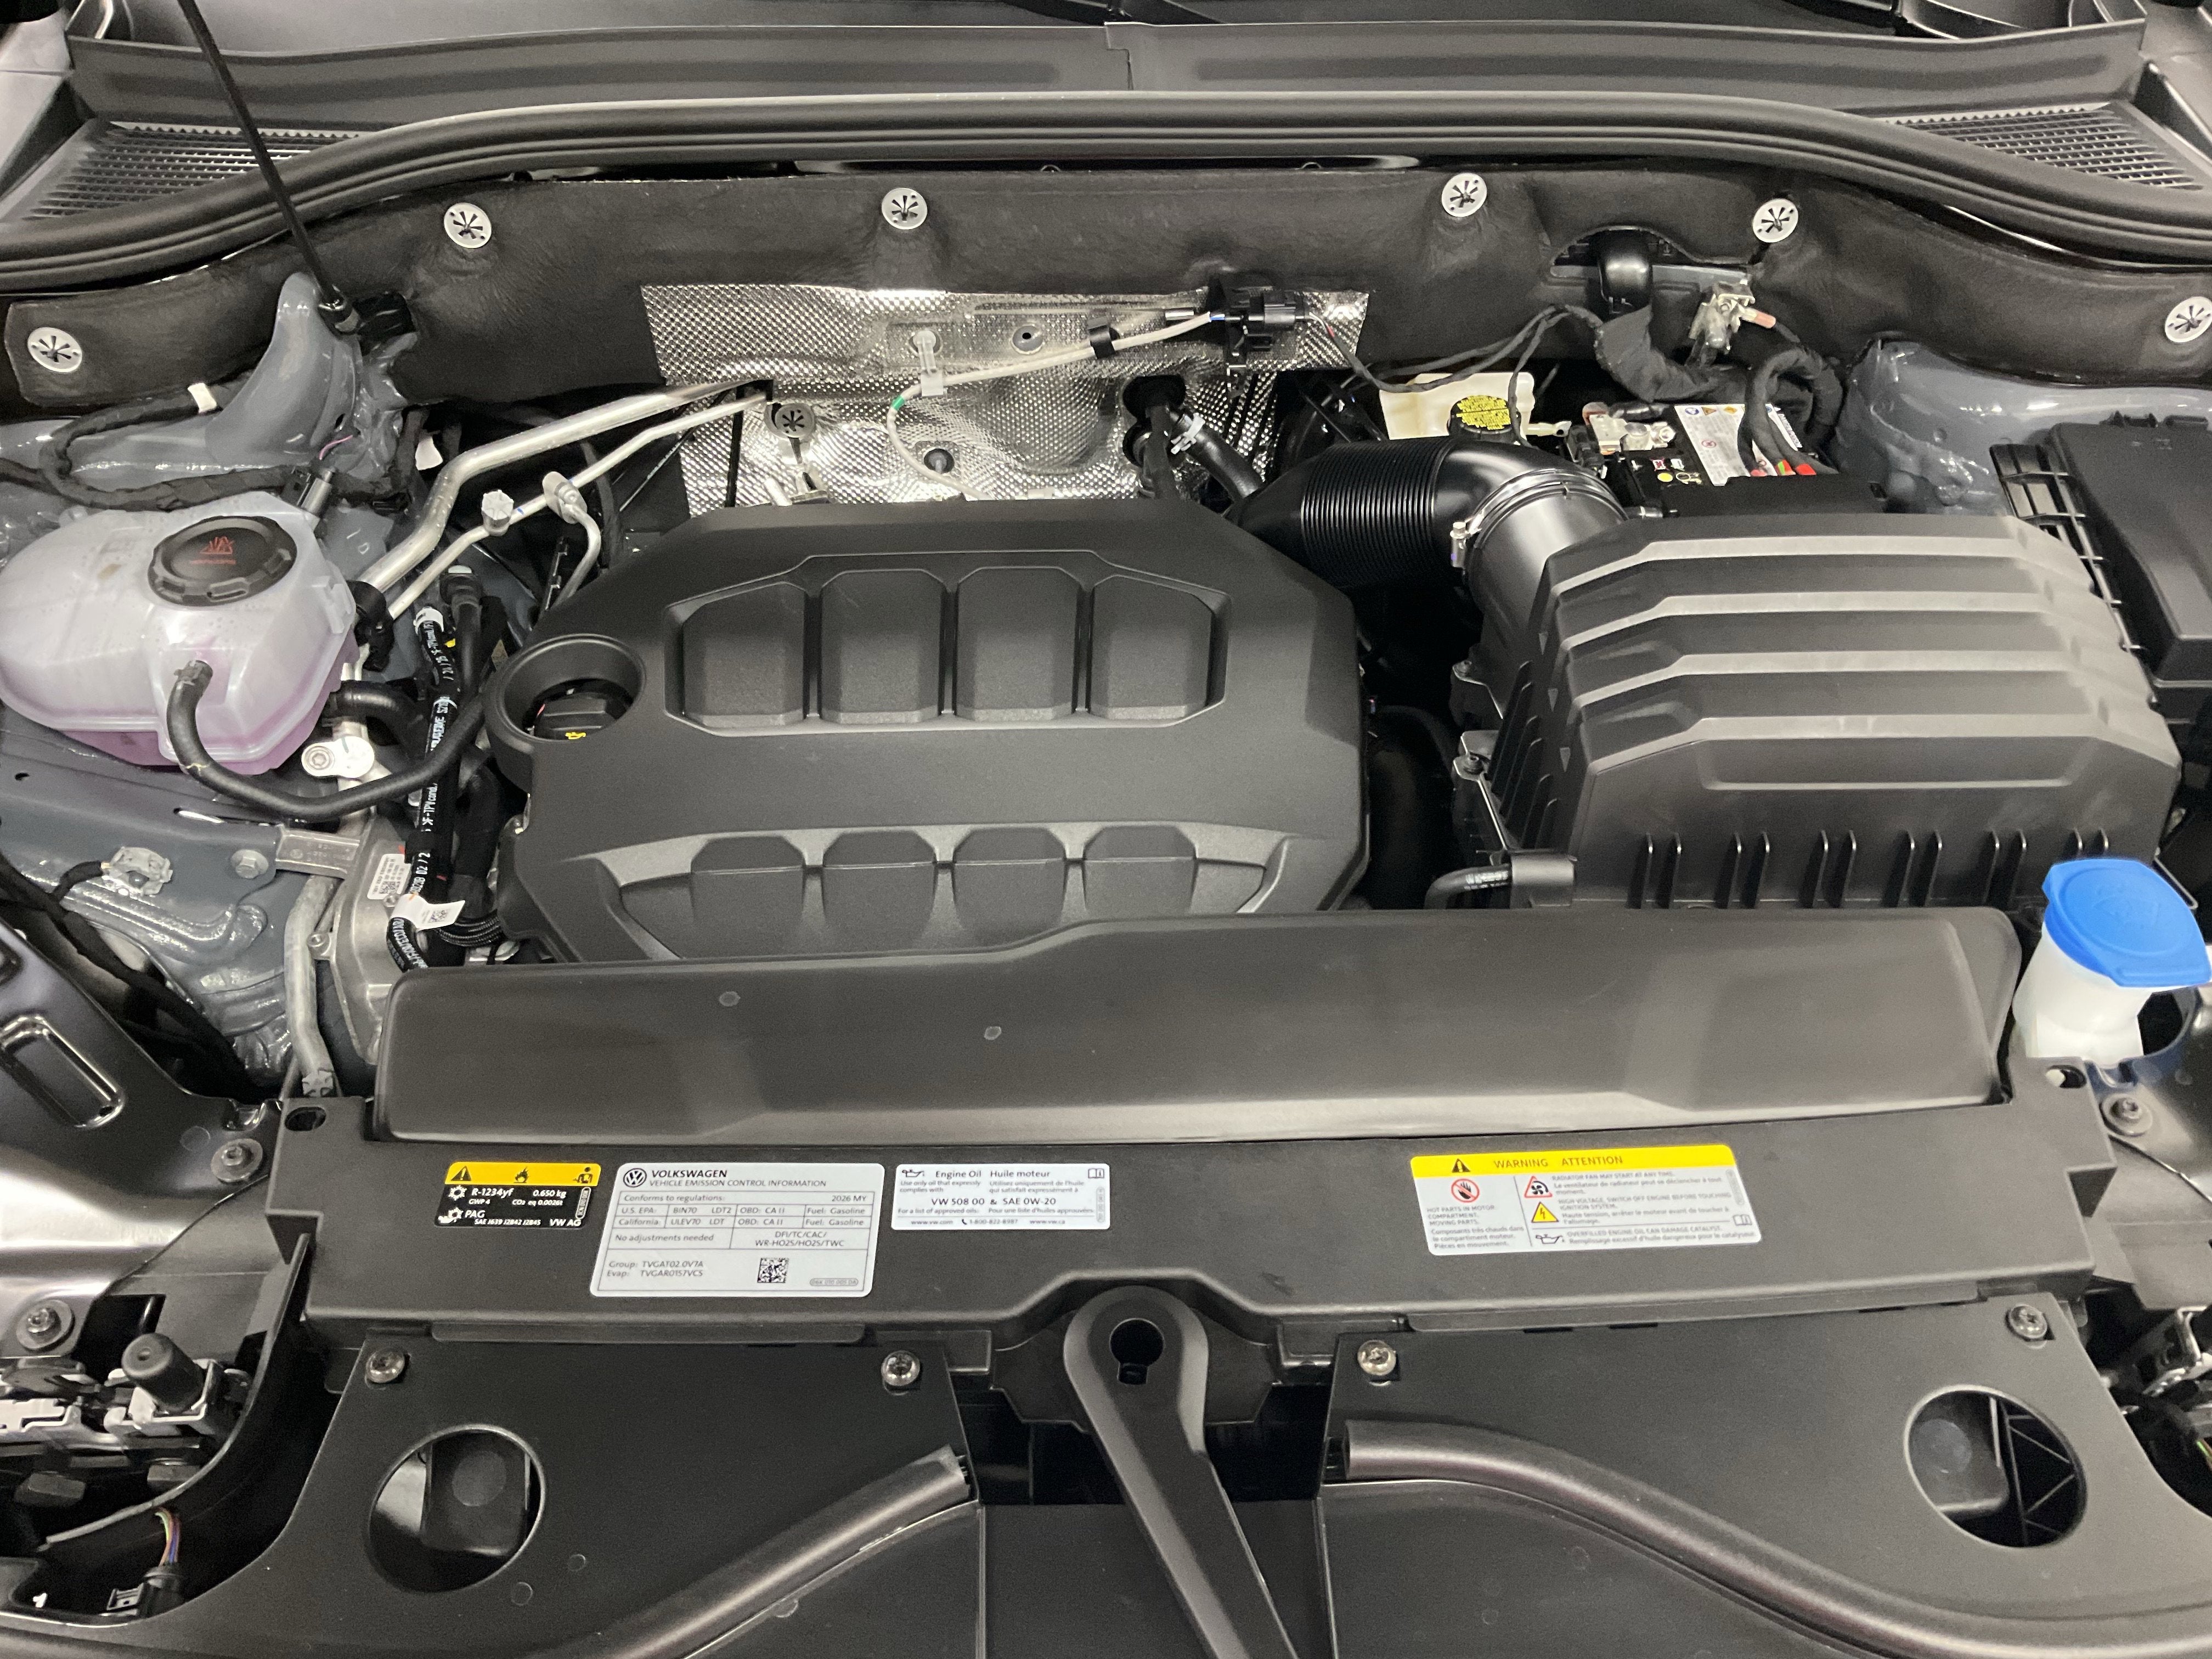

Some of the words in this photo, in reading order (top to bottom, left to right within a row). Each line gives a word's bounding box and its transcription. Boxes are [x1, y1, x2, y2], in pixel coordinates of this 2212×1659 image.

[1493, 1158, 1549, 1169] WARNING
[1561, 1155, 1623, 1166] ATTENTION
[651, 1169, 727, 1178] VOLKSWAGEN
[935, 1170, 966, 1180] Engine
[990, 1170, 1014, 1178] Huile
[951, 1180, 981, 1188] expressly
[472, 1188, 515, 1199] R-1234yf
[556, 1190, 567, 1199] kg
[465, 1210, 487, 1218] PAG
[629, 1234, 681, 1244] adjustments
[608, 1261, 638, 1269] Group:
[606, 1269, 629, 1279] Evap:
